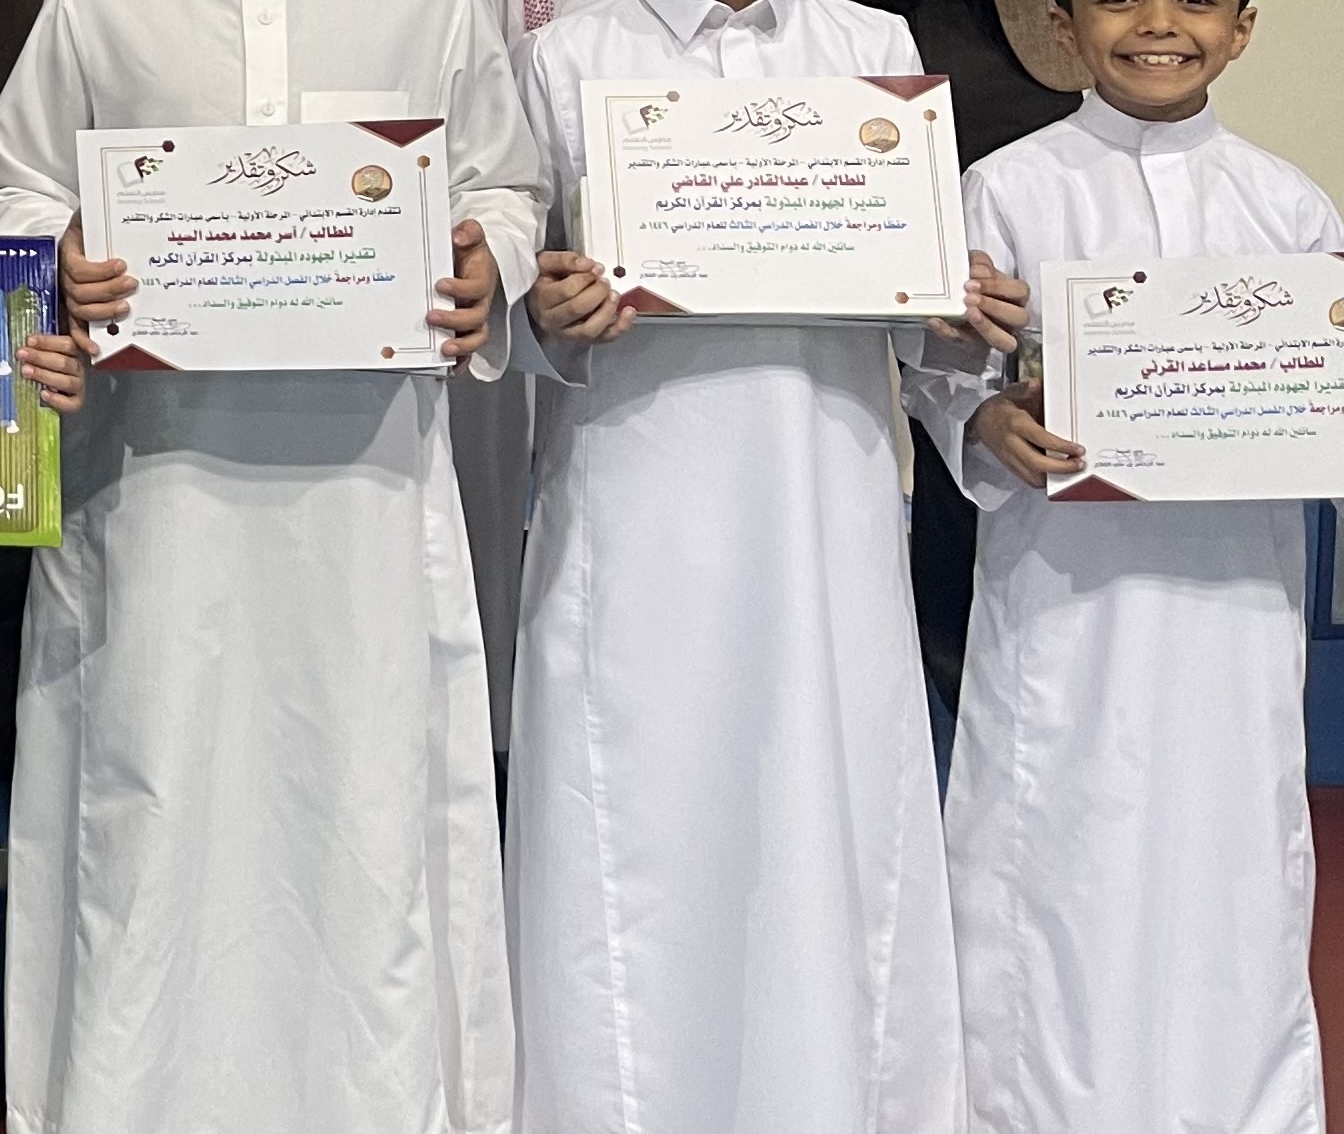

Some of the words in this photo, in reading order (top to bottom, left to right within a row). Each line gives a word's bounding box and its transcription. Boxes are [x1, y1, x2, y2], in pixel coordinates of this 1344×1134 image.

[672, 174, 717, 193] القاضي
[721, 176, 743, 192] علي
[822, 174, 865, 189] للطالب
[656, 197, 690, 211] الكريم
[730, 197, 761, 212] بمركز
[168, 229, 202, 246] السيد
[205, 230, 236, 241] محمد
[240, 230, 271, 241] محمد
[309, 226, 353, 242] للطالب
[149, 252, 183, 267] الكريم
[222, 252, 252, 266] بمركز
[1234, 360, 1266, 370] محمد
[1280, 356, 1324, 373] للطالب
[1115, 384, 1152, 399] الكريم
